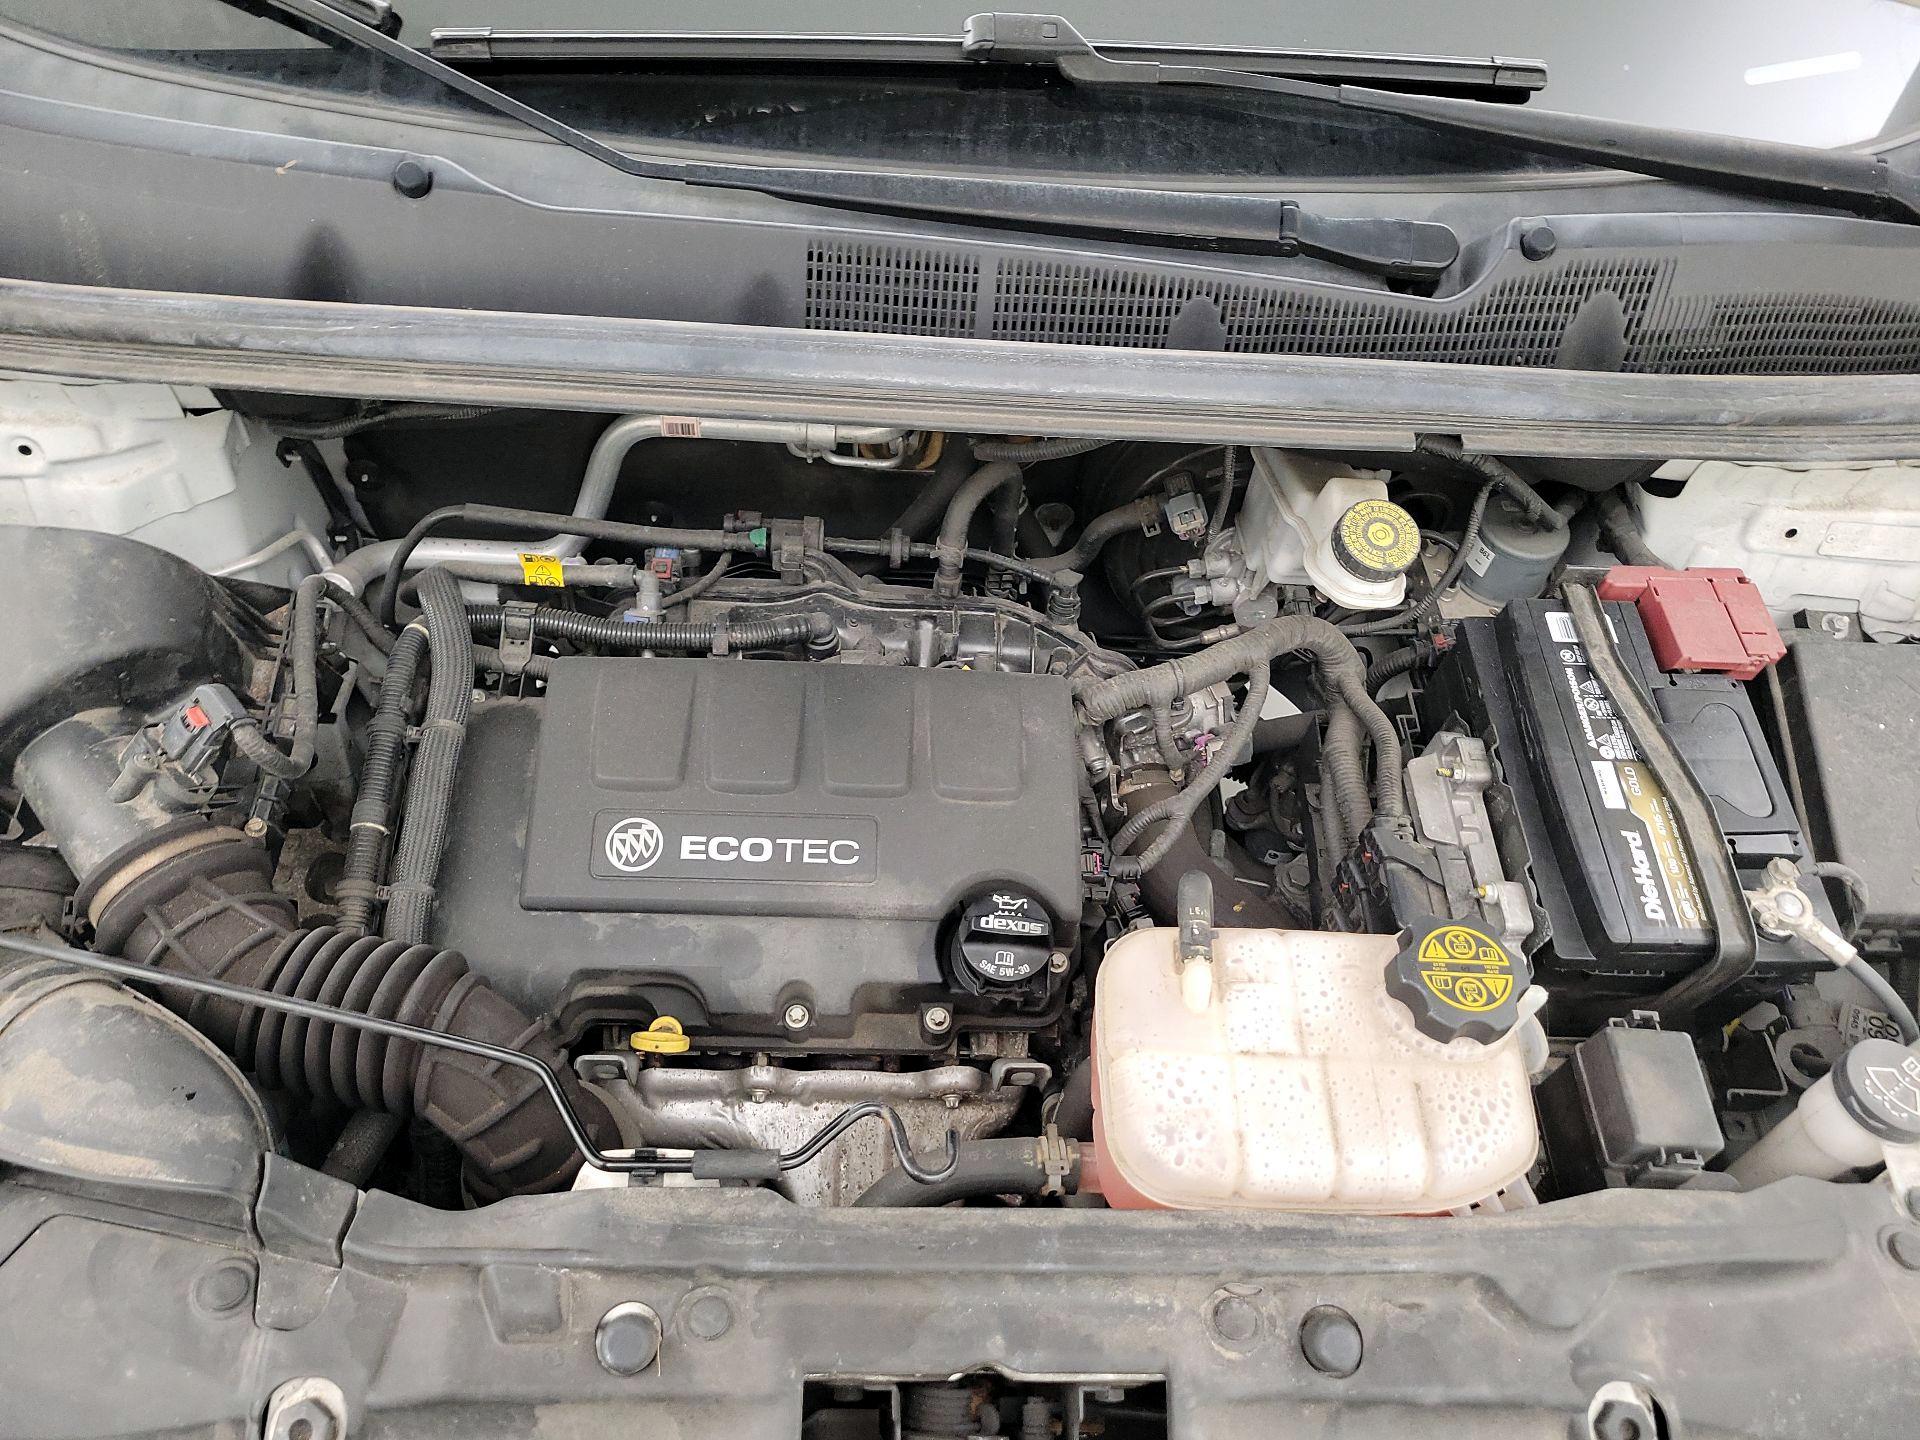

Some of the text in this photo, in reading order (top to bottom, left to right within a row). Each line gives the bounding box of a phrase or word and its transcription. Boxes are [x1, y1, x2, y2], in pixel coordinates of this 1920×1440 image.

[1624, 766, 1642, 796] GOLD
[680, 835, 860, 865] ECOTEC
[1620, 830, 1667, 921] DieHard
[980, 914, 1045, 934] dexos
[979, 959, 1031, 977] SAE 5W-30
